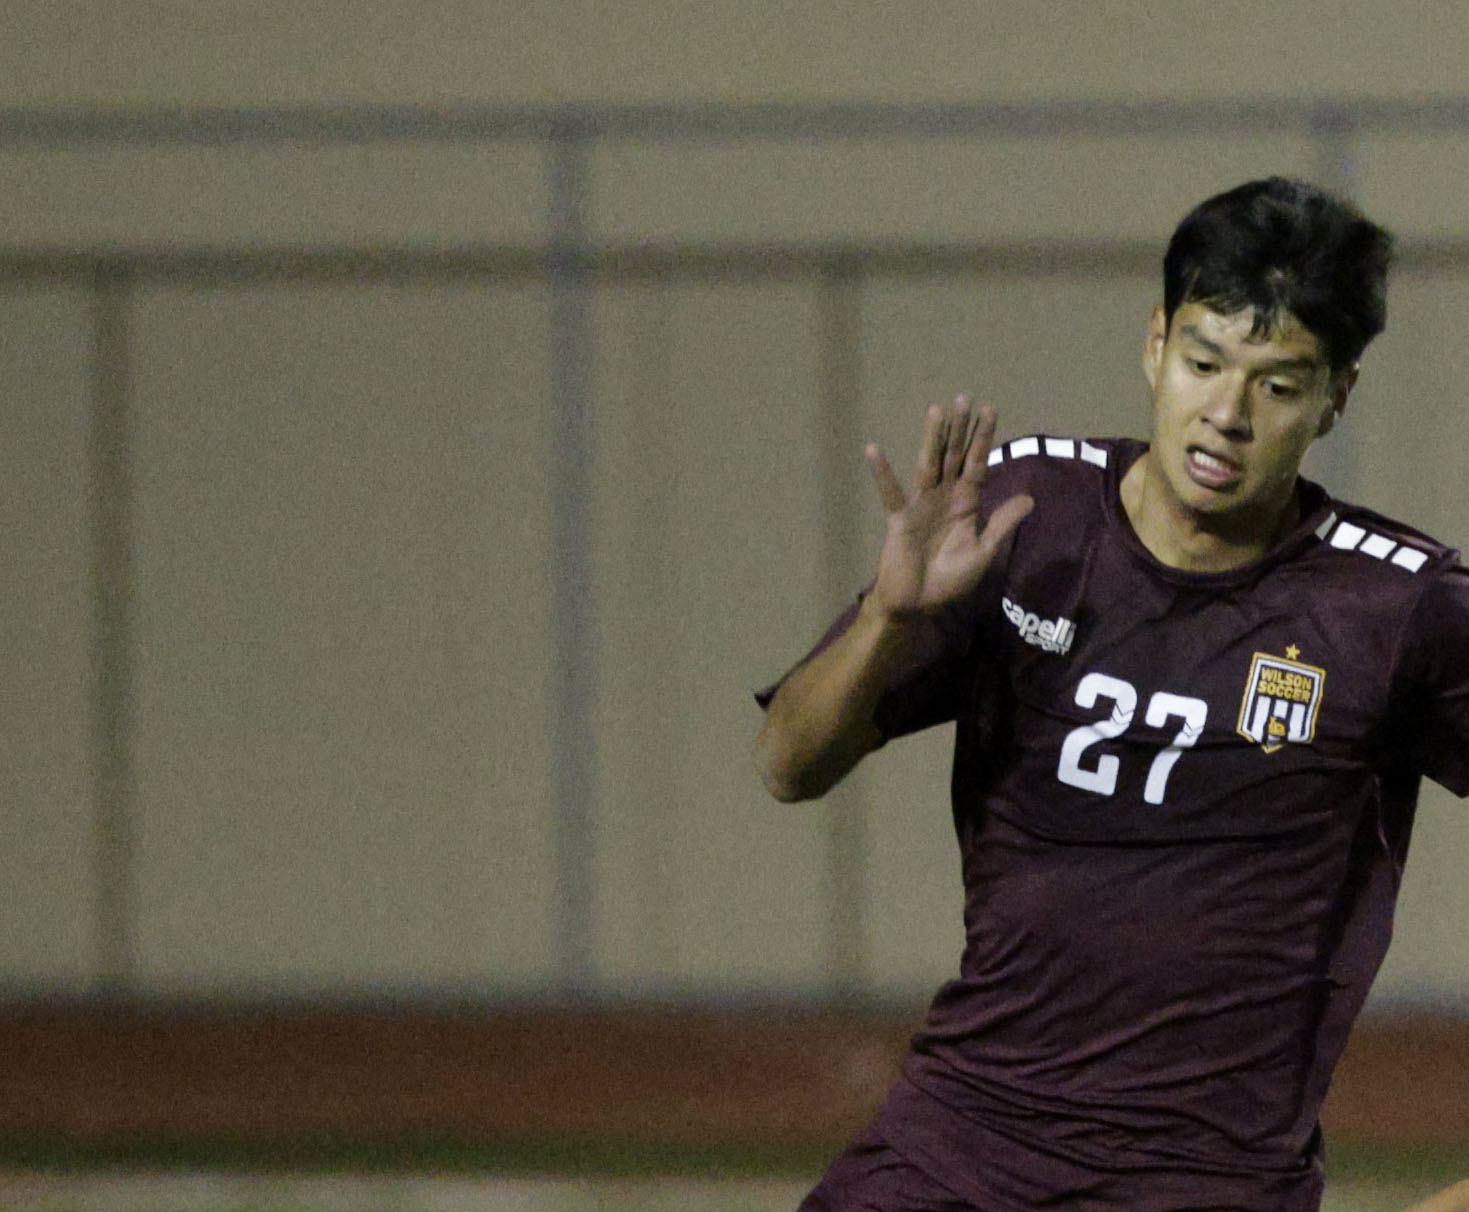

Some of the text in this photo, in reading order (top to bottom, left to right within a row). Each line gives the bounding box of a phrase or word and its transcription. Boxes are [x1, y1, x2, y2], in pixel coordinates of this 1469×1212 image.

[1002, 597, 1077, 648] capelli
[1258, 680, 1311, 703] SOCCER
[1261, 667, 1312, 690] WILSON
[1057, 672, 1208, 805] 27
